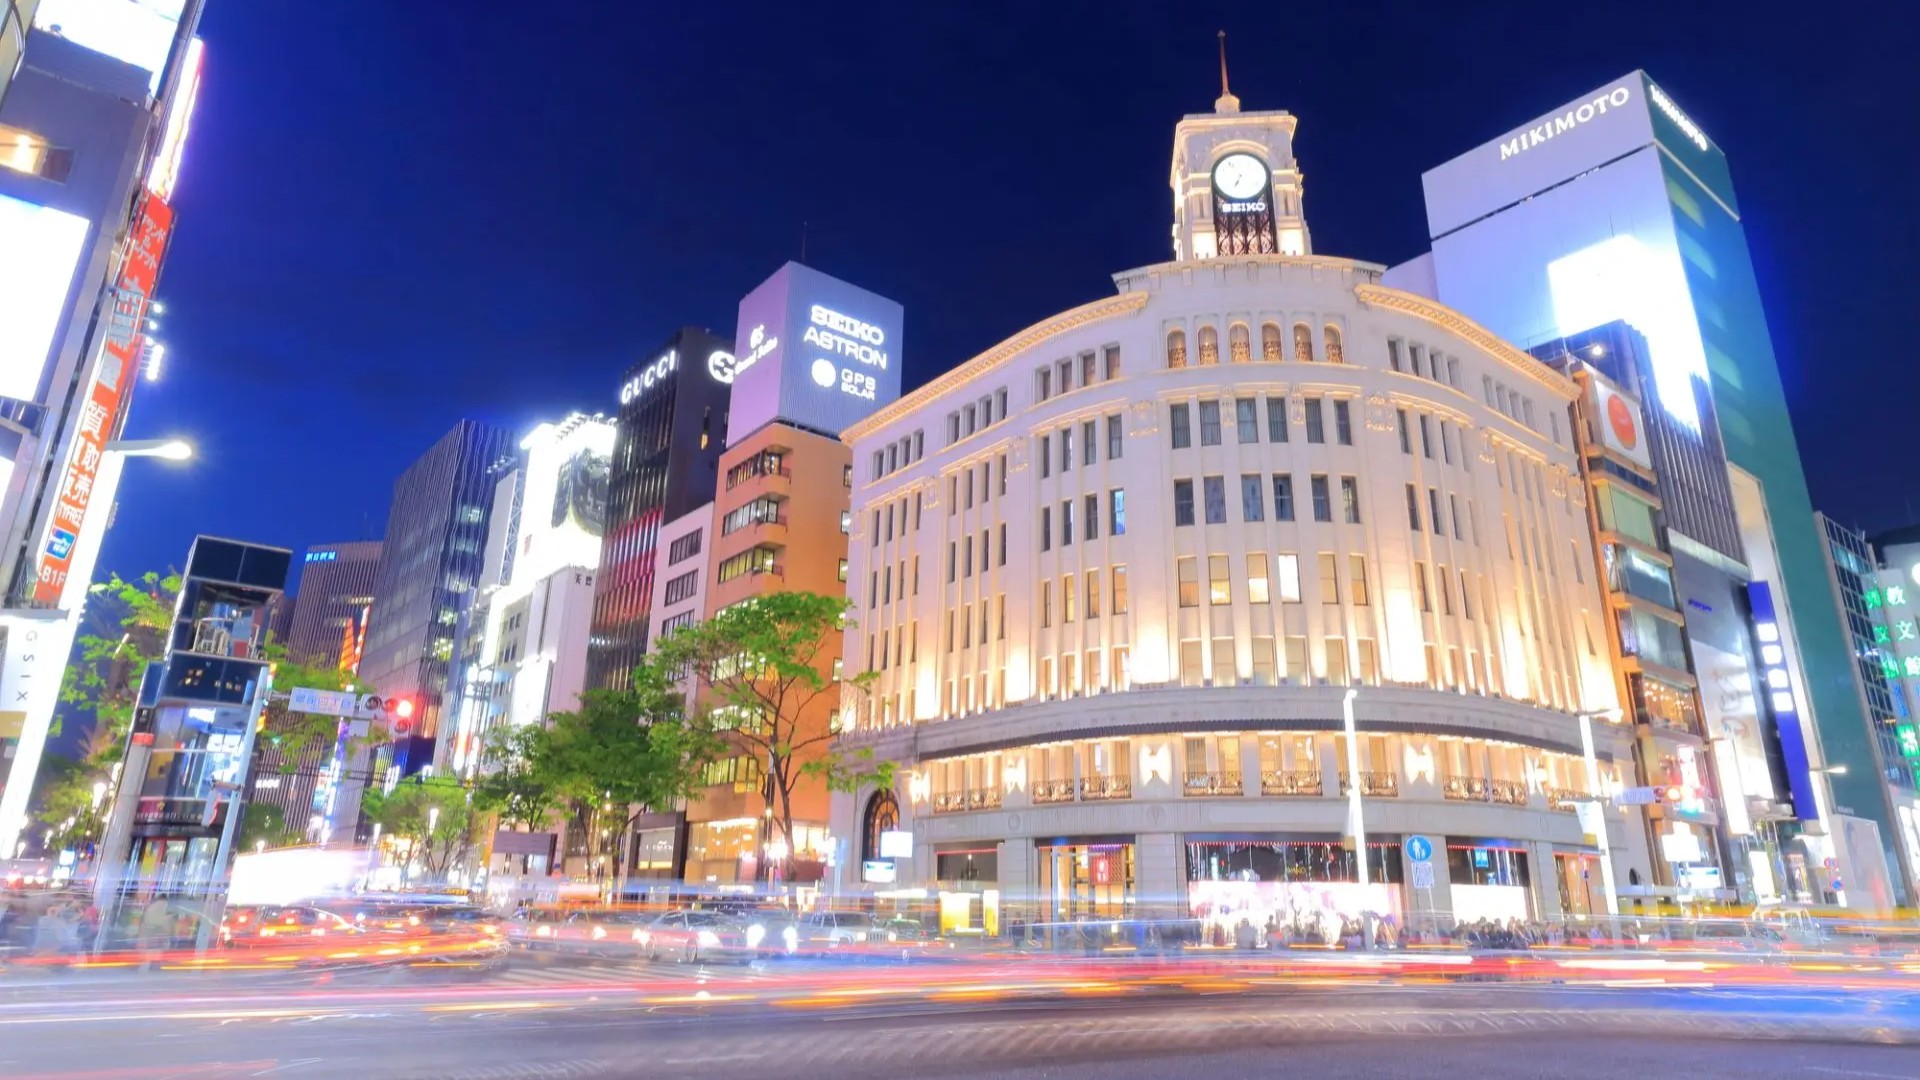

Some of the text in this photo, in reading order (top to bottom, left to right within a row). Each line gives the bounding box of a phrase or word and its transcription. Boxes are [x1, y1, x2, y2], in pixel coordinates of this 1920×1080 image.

[1500, 87, 1630, 160] MIKIMOTO
[1222, 202, 1266, 213] SEIKO
[811, 304, 885, 346] SEIKO
[803, 326, 887, 370] ASTRON
[621, 350, 676, 404] GUCCI
[841, 368, 876, 391] GPS
[841, 381, 876, 401] SOLAR
